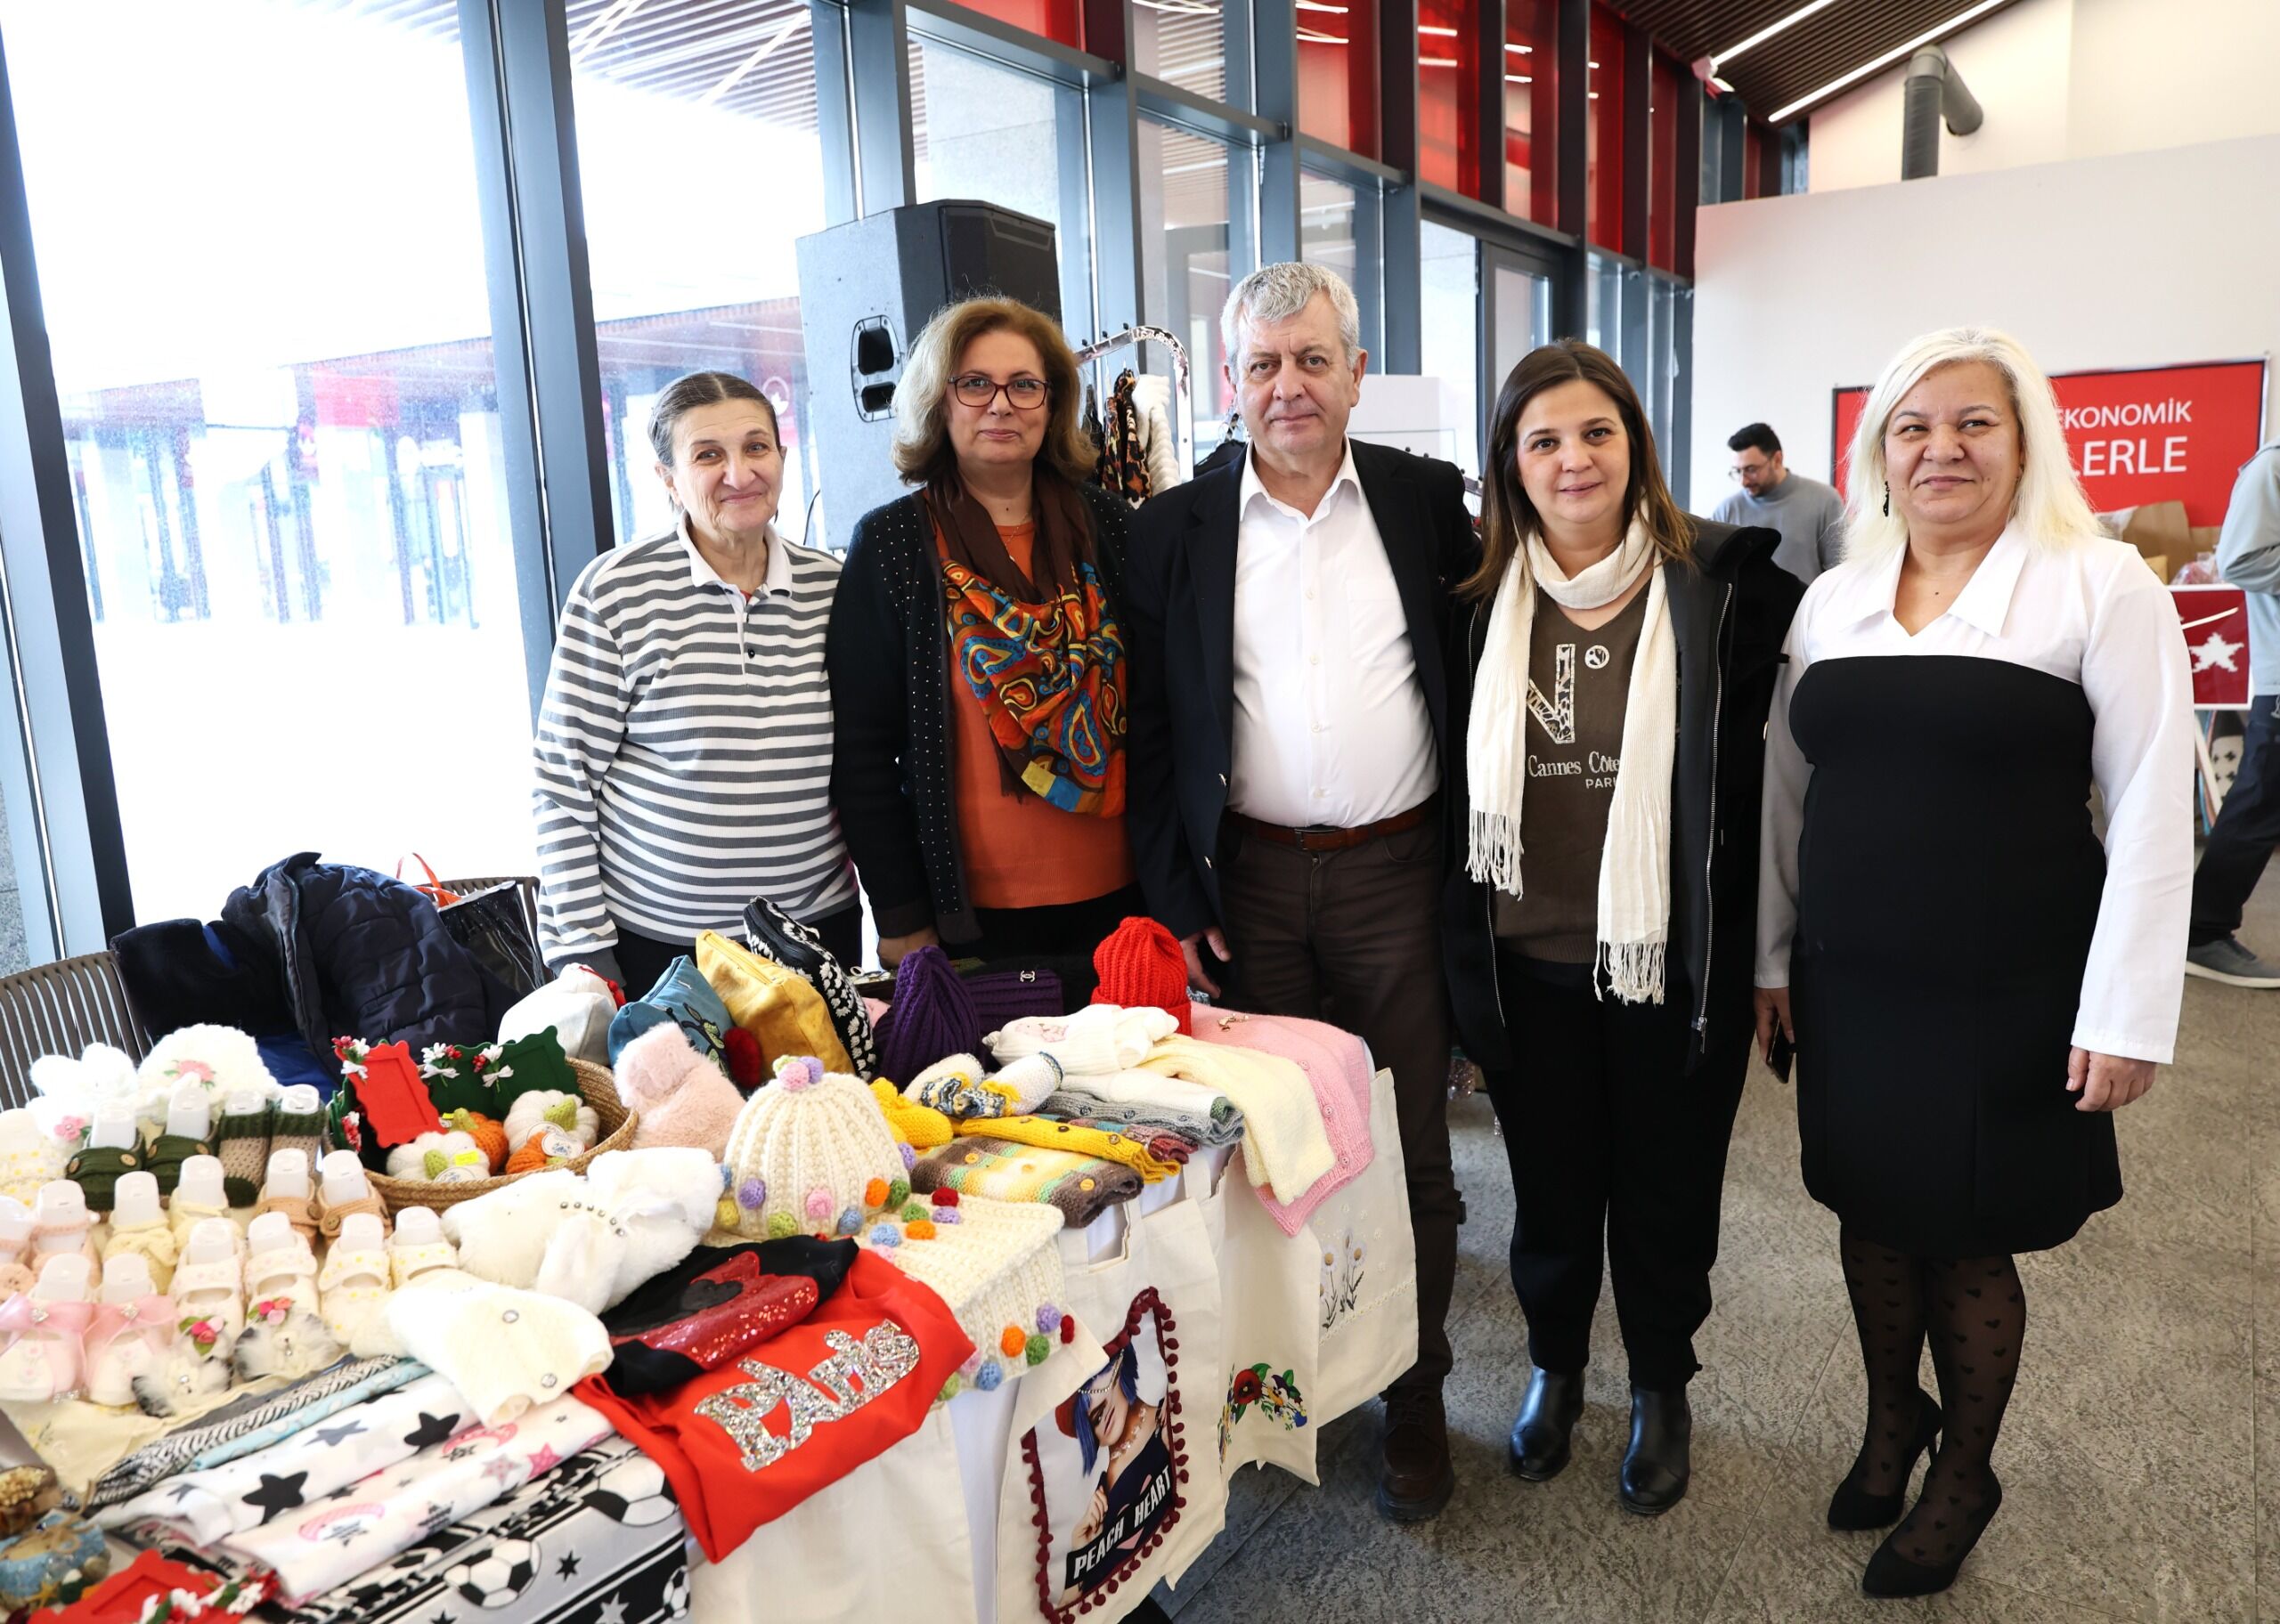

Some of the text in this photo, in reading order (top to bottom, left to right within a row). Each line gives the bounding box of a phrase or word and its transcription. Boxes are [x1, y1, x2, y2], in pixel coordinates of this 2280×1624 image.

[2073, 435, 2188, 477] ERLE
[1527, 754, 1582, 777] Cannes
[1073, 1465, 1172, 1579] PEACH HEART
